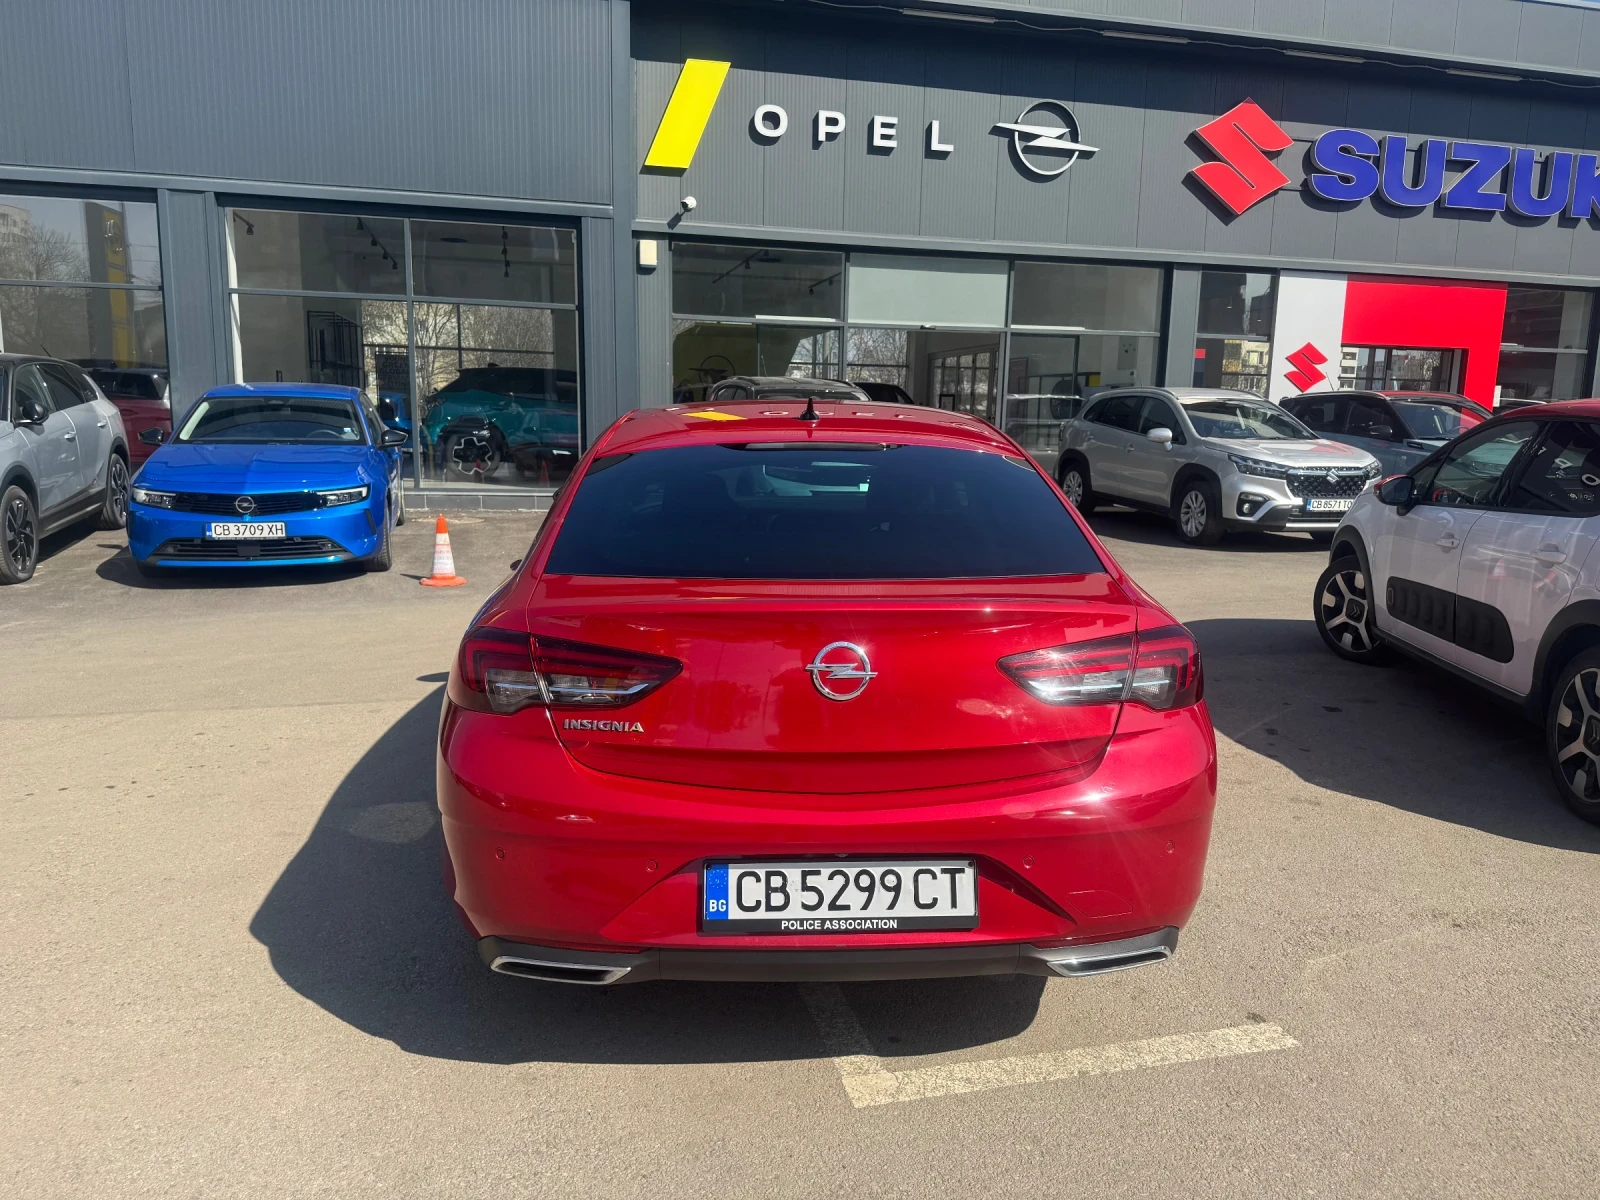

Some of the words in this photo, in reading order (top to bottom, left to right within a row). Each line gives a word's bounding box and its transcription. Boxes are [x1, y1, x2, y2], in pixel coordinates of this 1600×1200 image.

[754, 104, 954, 152] OPEL
[1311, 500, 1322, 509] CB
[213, 524, 231, 536] CB
[233, 524, 264, 536] 3709
[267, 524, 284, 536] XH
[563, 718, 645, 733] INSIGNIA
[709, 899, 727, 912] BG
[735, 869, 791, 913] CB
[800, 868, 902, 912] 5299
[912, 867, 966, 911] CT
[781, 920, 822, 931] POLICE
[823, 919, 898, 930] ASSOCIATION
